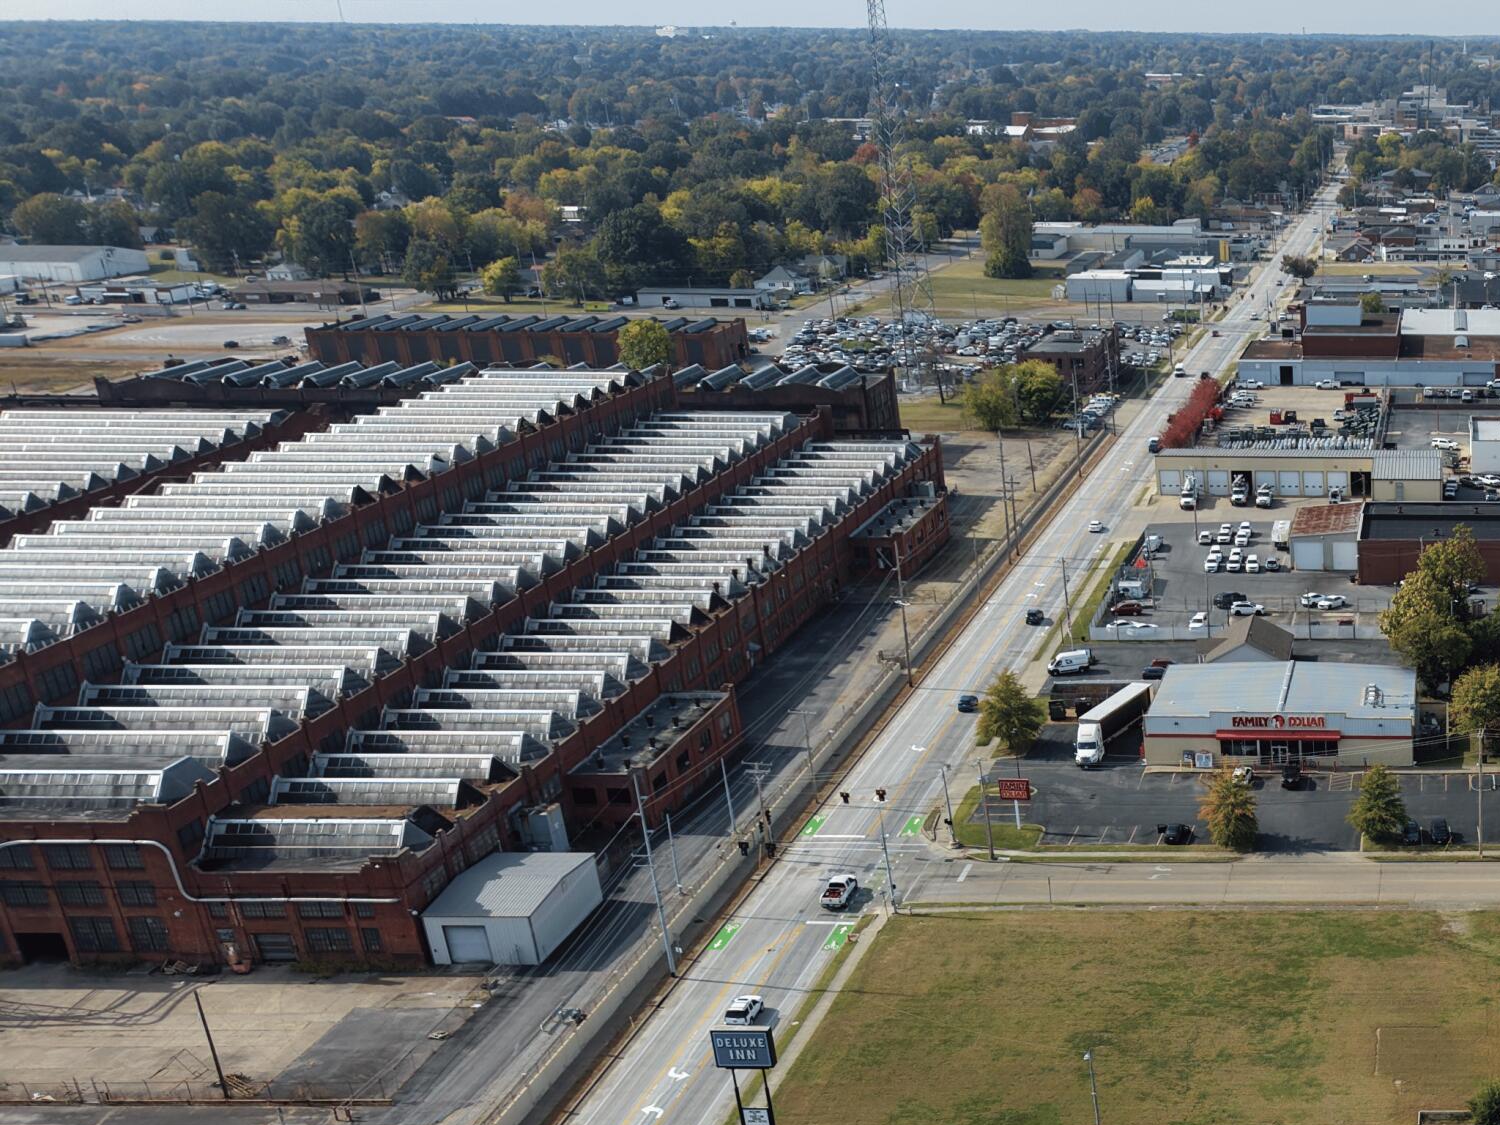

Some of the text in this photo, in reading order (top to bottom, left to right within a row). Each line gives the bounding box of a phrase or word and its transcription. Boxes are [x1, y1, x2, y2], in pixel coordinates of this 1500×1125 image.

[1232, 716, 1269, 727] FAMILY
[716, 1038, 765, 1048] DELUXE
[729, 1049, 756, 1060] INN
